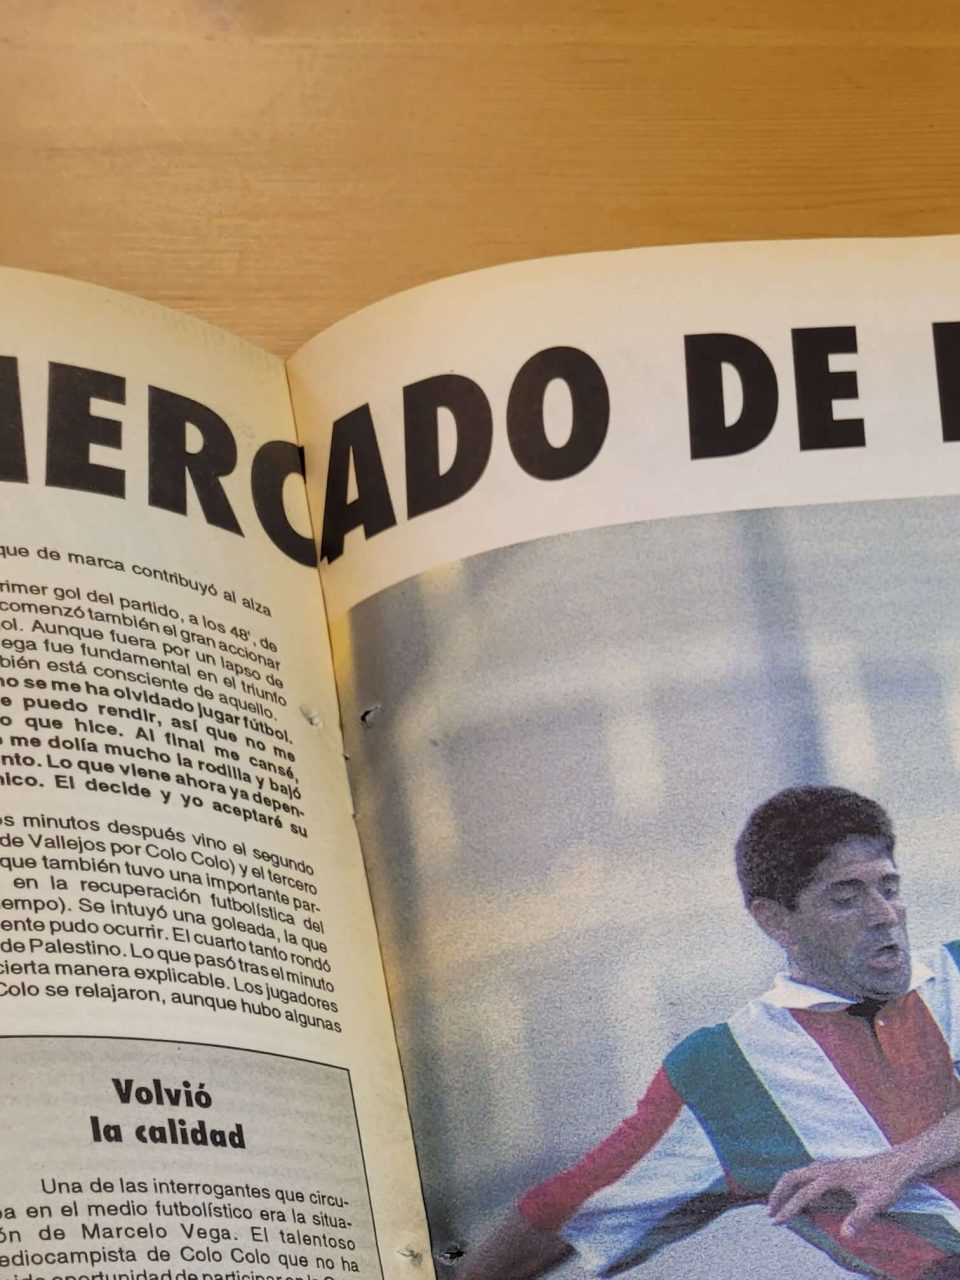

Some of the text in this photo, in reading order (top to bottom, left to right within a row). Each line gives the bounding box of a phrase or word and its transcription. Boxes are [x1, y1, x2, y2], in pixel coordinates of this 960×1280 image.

[0, 346, 610, 567] ERCADO
[684, 326, 866, 460] DE
[36, 546, 271, 617] de marca contribuyó al alza
[54, 774, 307, 838] El decide y yo aceptaré su
[0, 937, 334, 992] de Palestino. Lo que pasó tras el minuto
[44, 984, 69, 996] se
[74, 982, 165, 1004] relajaron,
[170, 991, 237, 1012] aunque
[240, 997, 281, 1018] hubo
[284, 1008, 342, 1033] algunas
[111, 1077, 212, 1108] Volvió
[89, 1115, 246, 1149] la calidad
[40, 1176, 349, 1208] Una de las interrogantes que circu-
